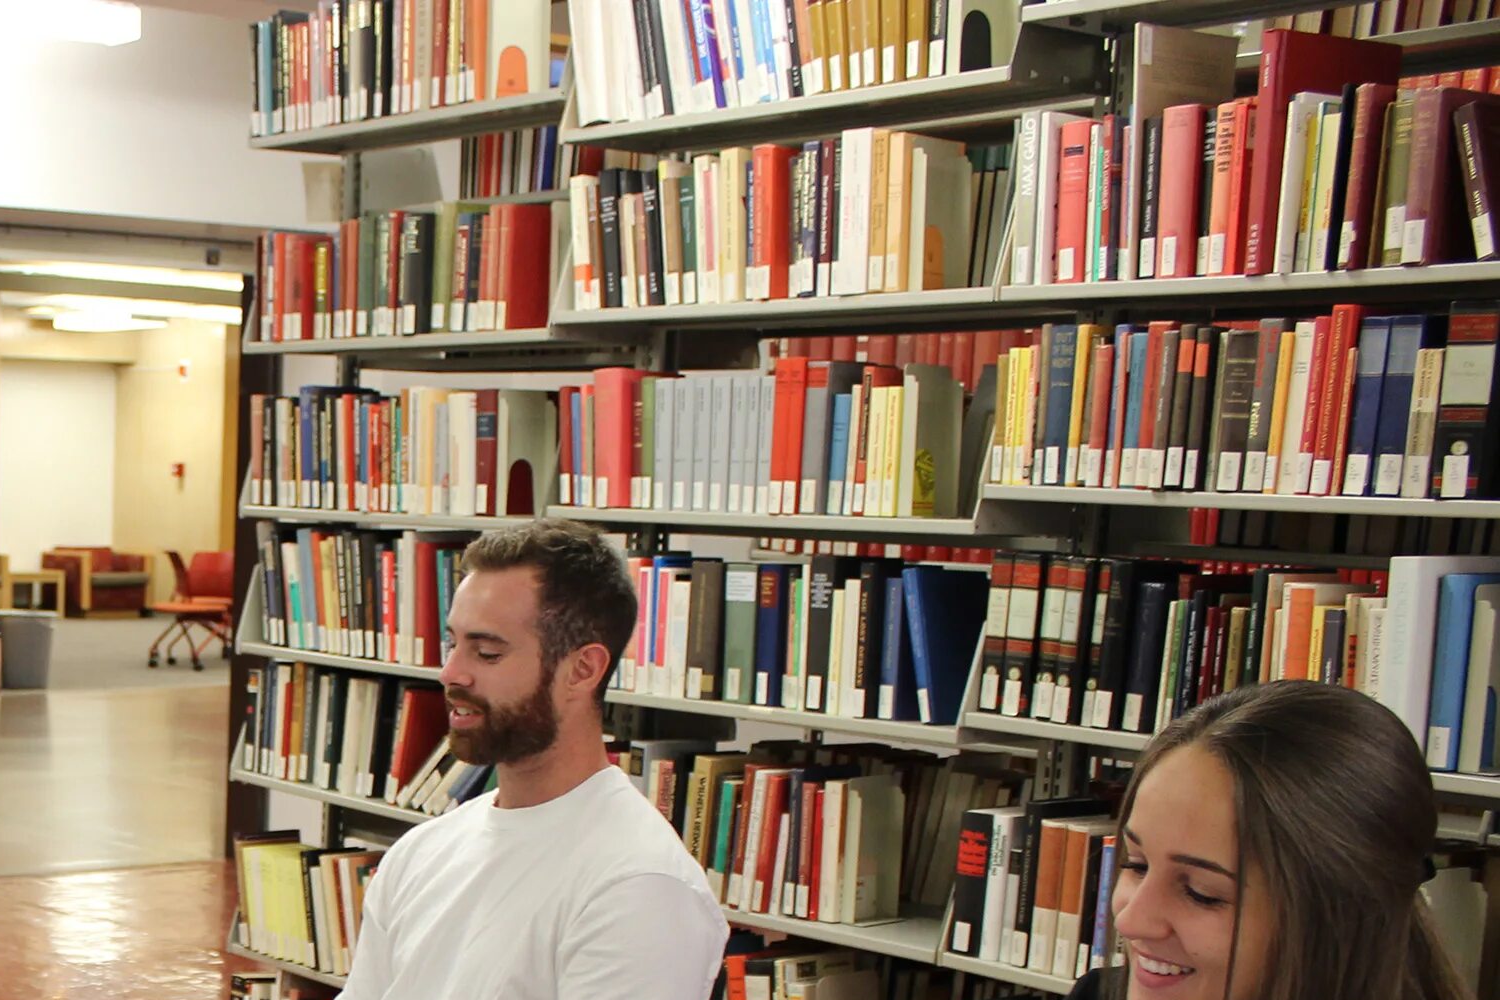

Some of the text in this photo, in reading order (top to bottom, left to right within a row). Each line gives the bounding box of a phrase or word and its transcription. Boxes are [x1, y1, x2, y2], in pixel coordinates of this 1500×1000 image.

[1021, 118, 1037, 196] MAX GALLO
[695, 776, 706, 819] WILHELM
